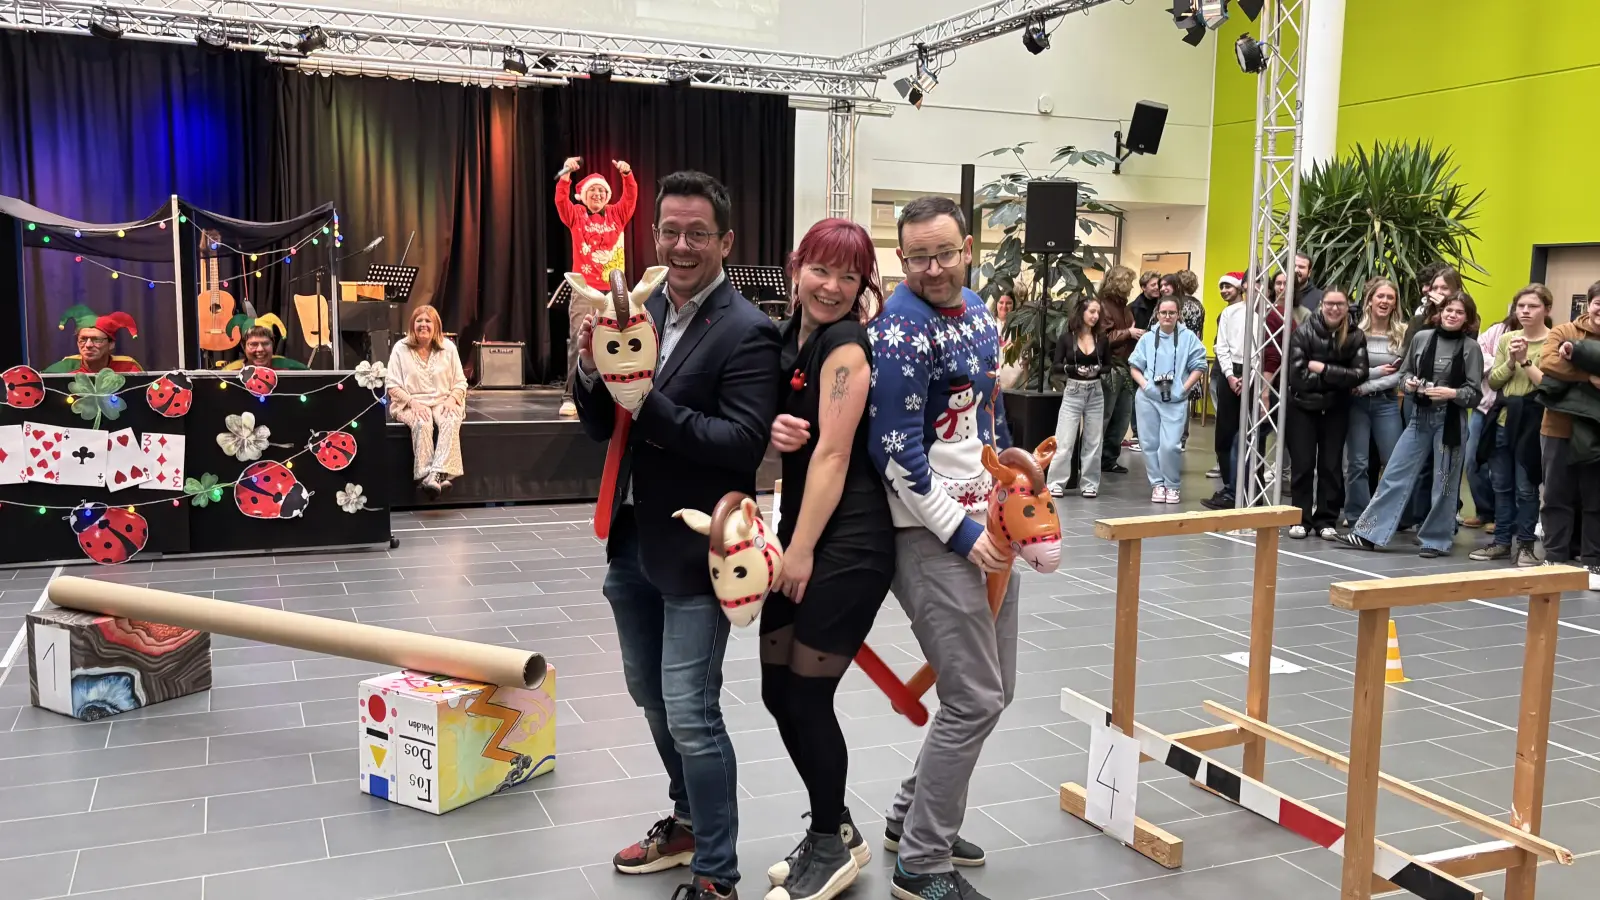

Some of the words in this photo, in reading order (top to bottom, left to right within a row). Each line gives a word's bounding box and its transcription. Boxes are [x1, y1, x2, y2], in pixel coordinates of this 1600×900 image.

[25, 424, 32, 432] 8
[143, 434, 152, 446] 3
[172, 476, 182, 487] 3
[43, 642, 56, 690] 1
[405, 744, 432, 770] Bos
[410, 774, 432, 802] Fos
[1096, 744, 1119, 819] 4
